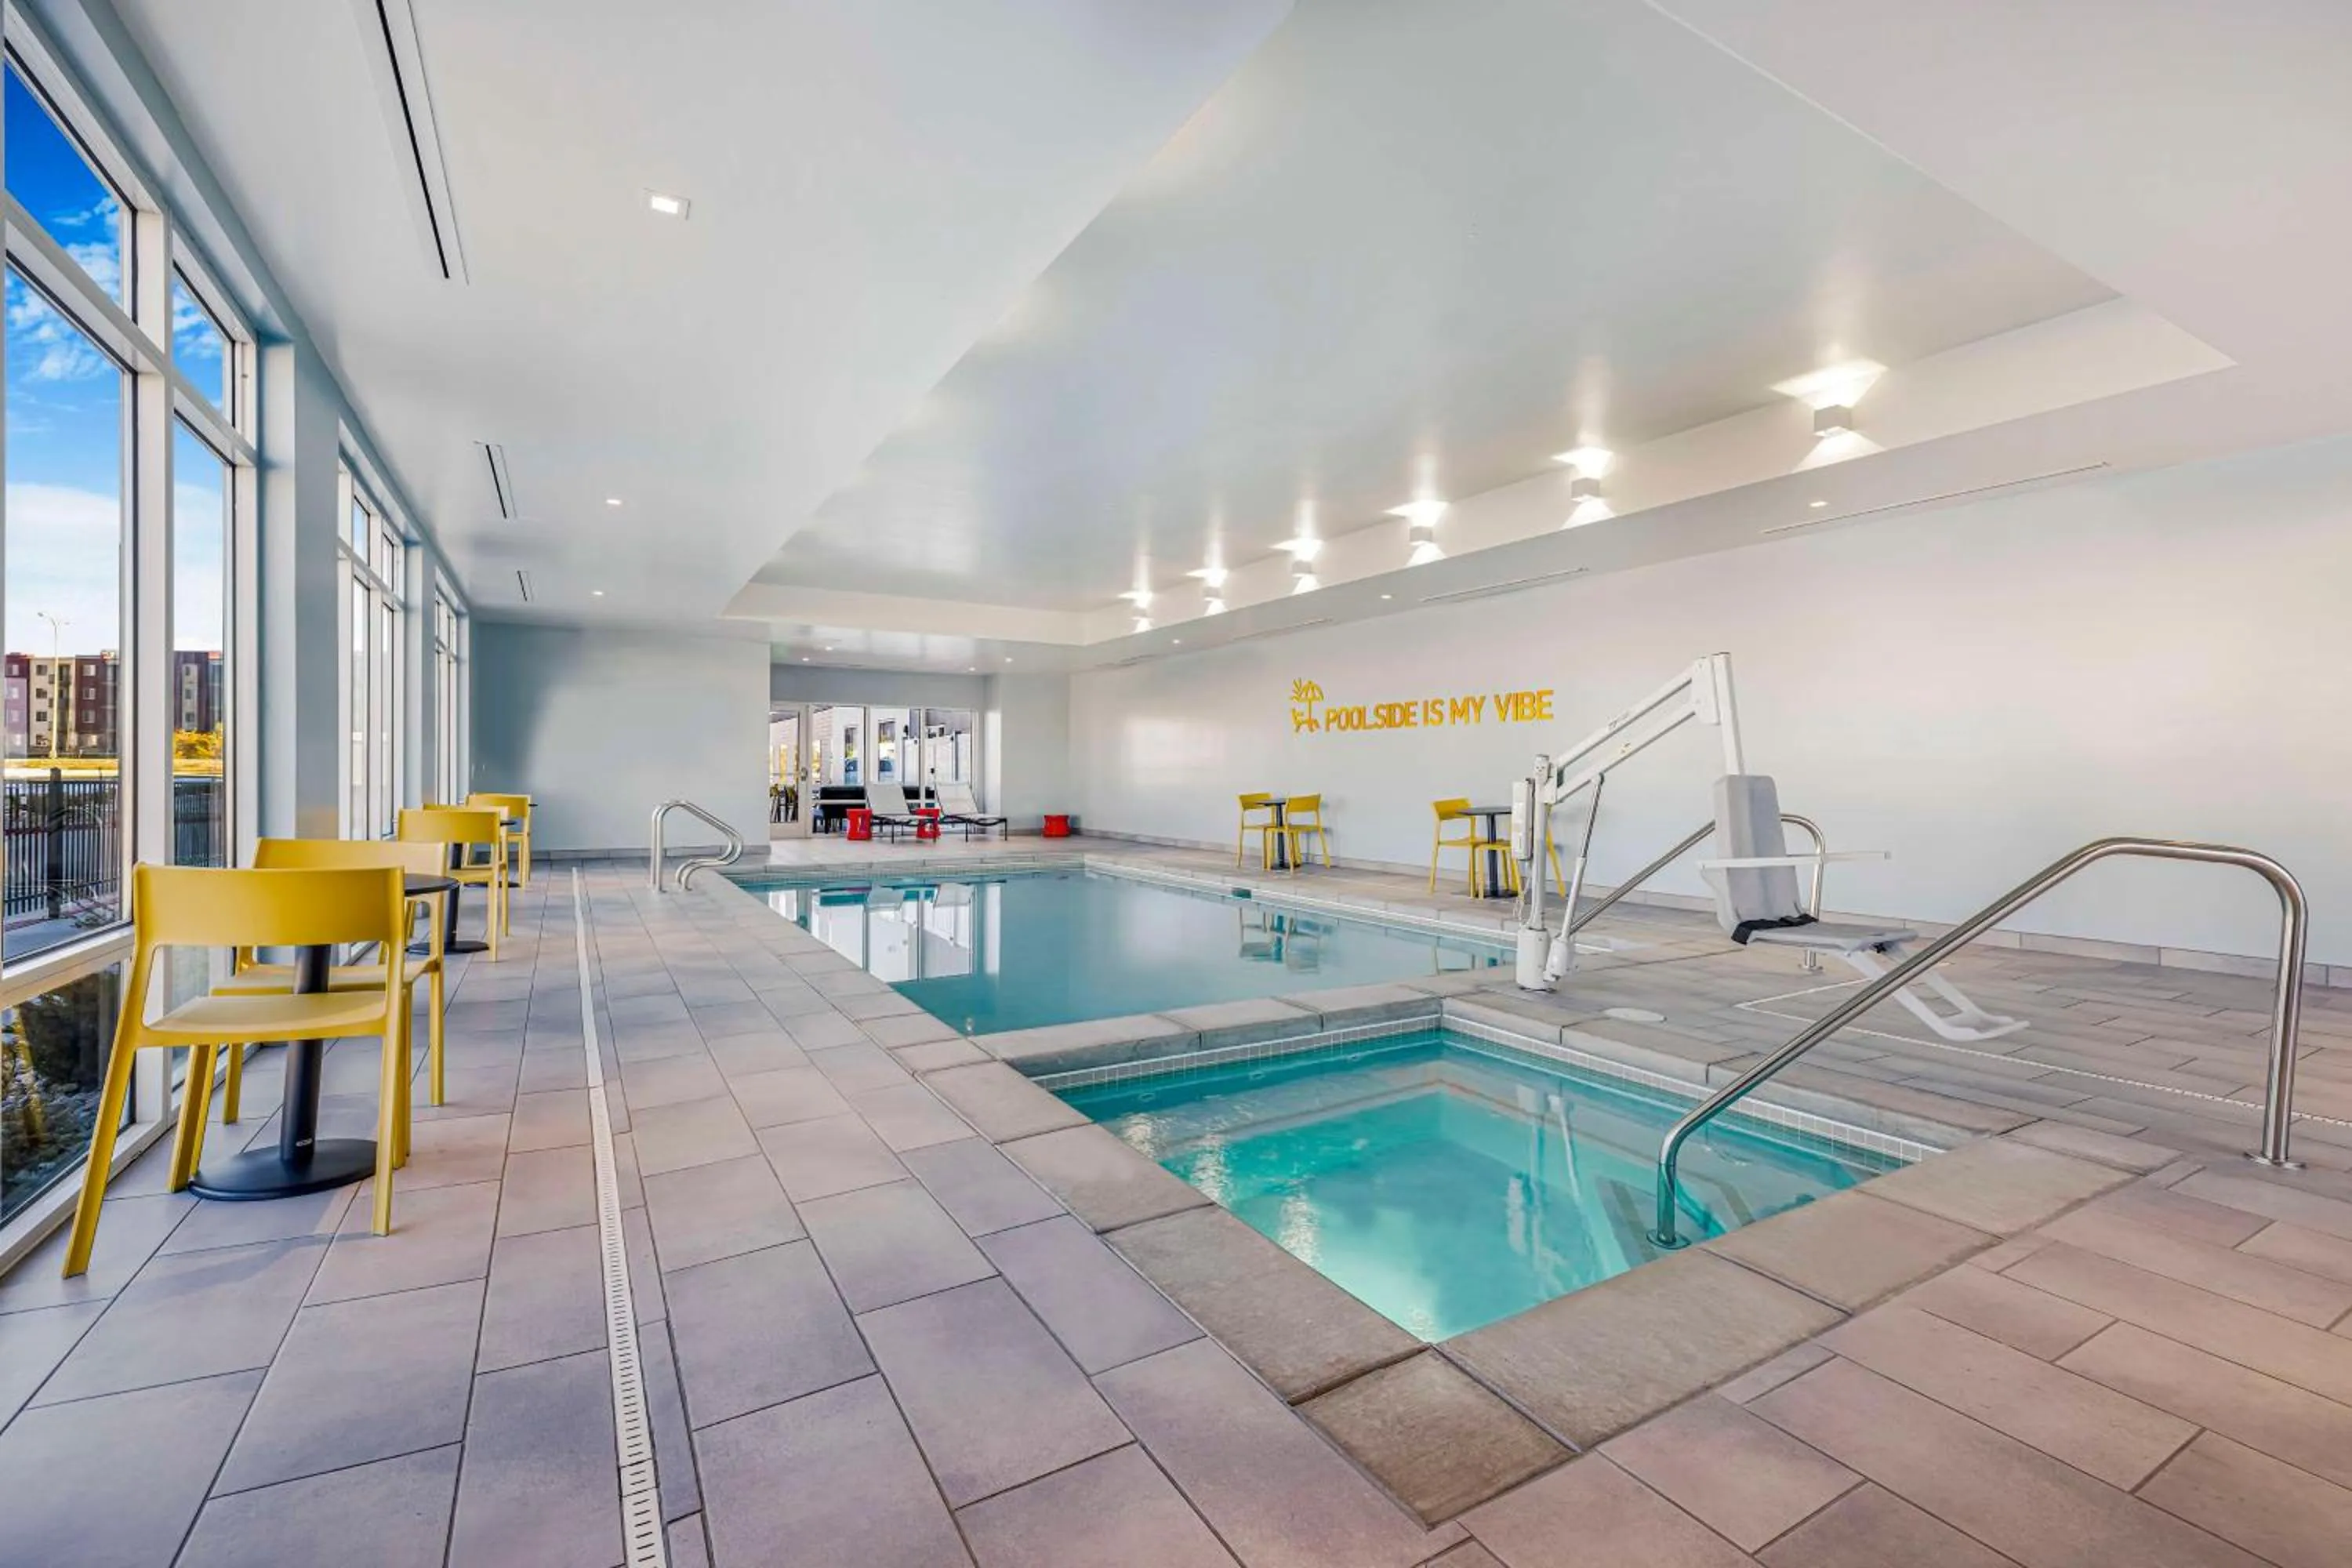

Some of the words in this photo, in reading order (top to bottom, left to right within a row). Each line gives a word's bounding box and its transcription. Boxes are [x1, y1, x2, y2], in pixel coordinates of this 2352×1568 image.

[1324, 701, 1418, 732] POOLSIDE
[1422, 699, 1443, 727] IS
[1449, 695, 1486, 725] MY
[1494, 689, 1555, 723] VIBE
